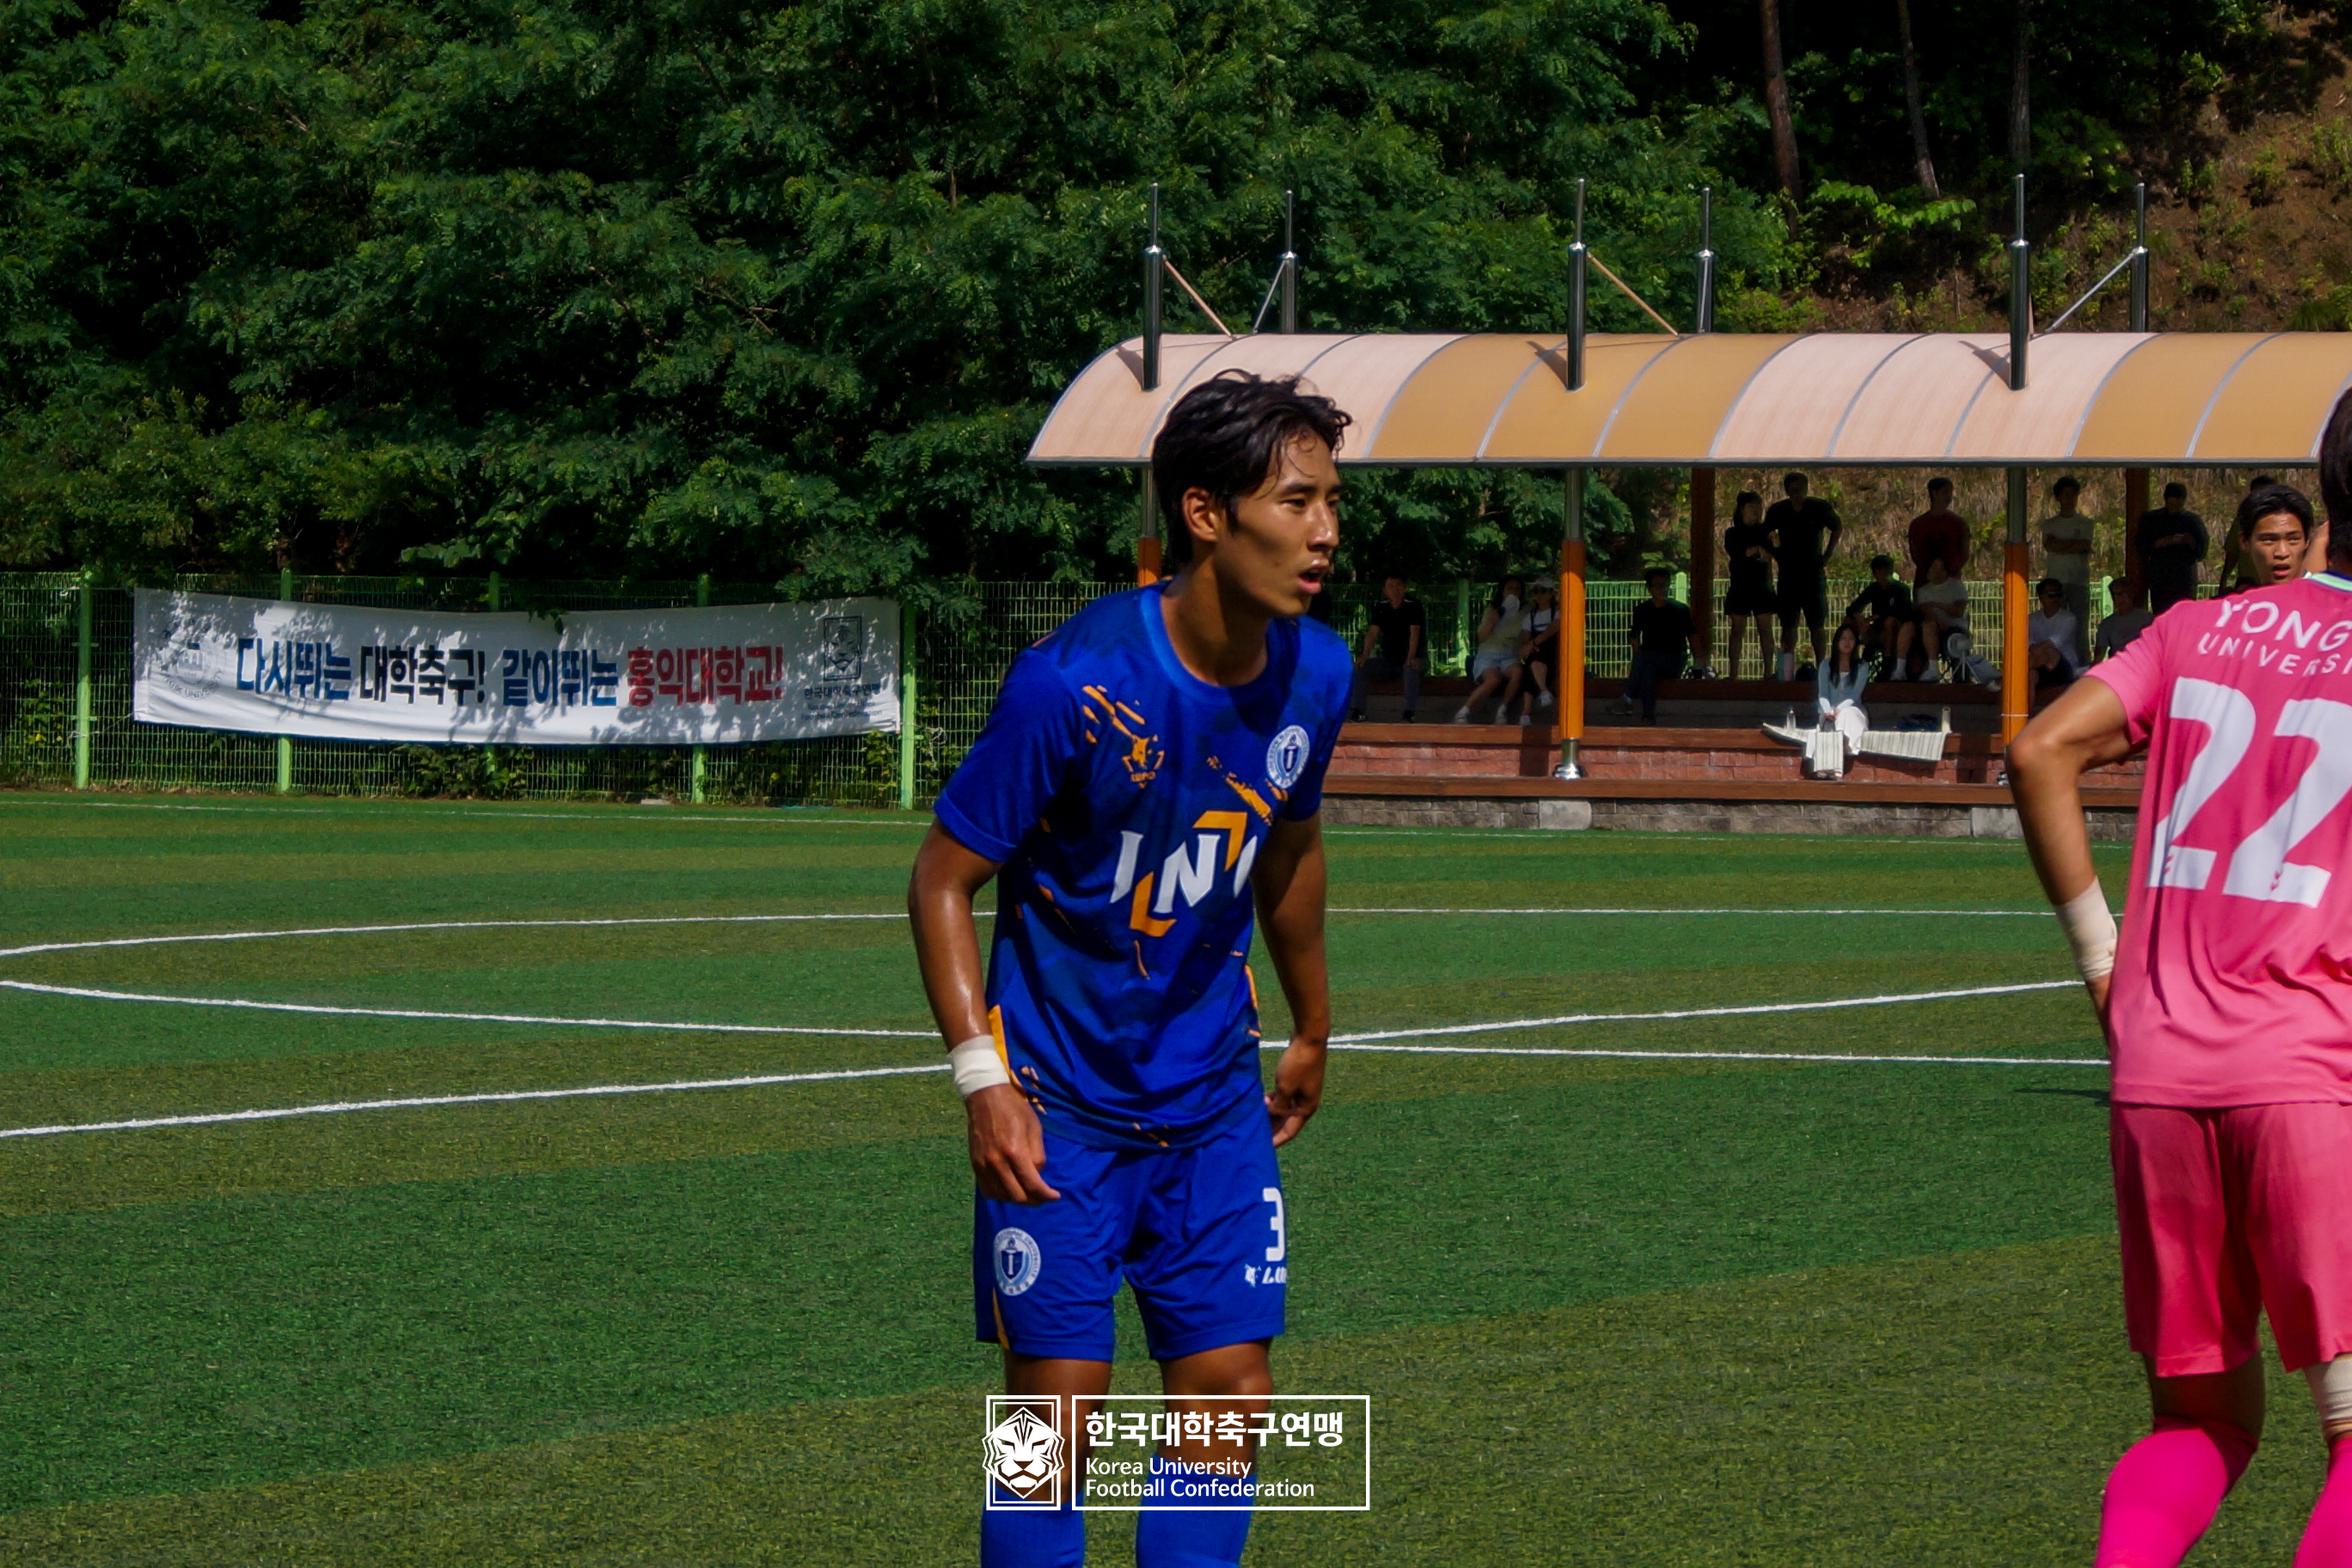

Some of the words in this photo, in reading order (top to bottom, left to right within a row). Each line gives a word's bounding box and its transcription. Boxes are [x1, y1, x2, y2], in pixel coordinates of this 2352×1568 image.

[236, 637, 352, 701] 다시뛰는
[359, 645, 485, 706] 대학축구!
[503, 648, 618, 707] 같이뛰는
[628, 646, 784, 707] 홍익대학교!
[2147, 676, 2352, 908] 22
